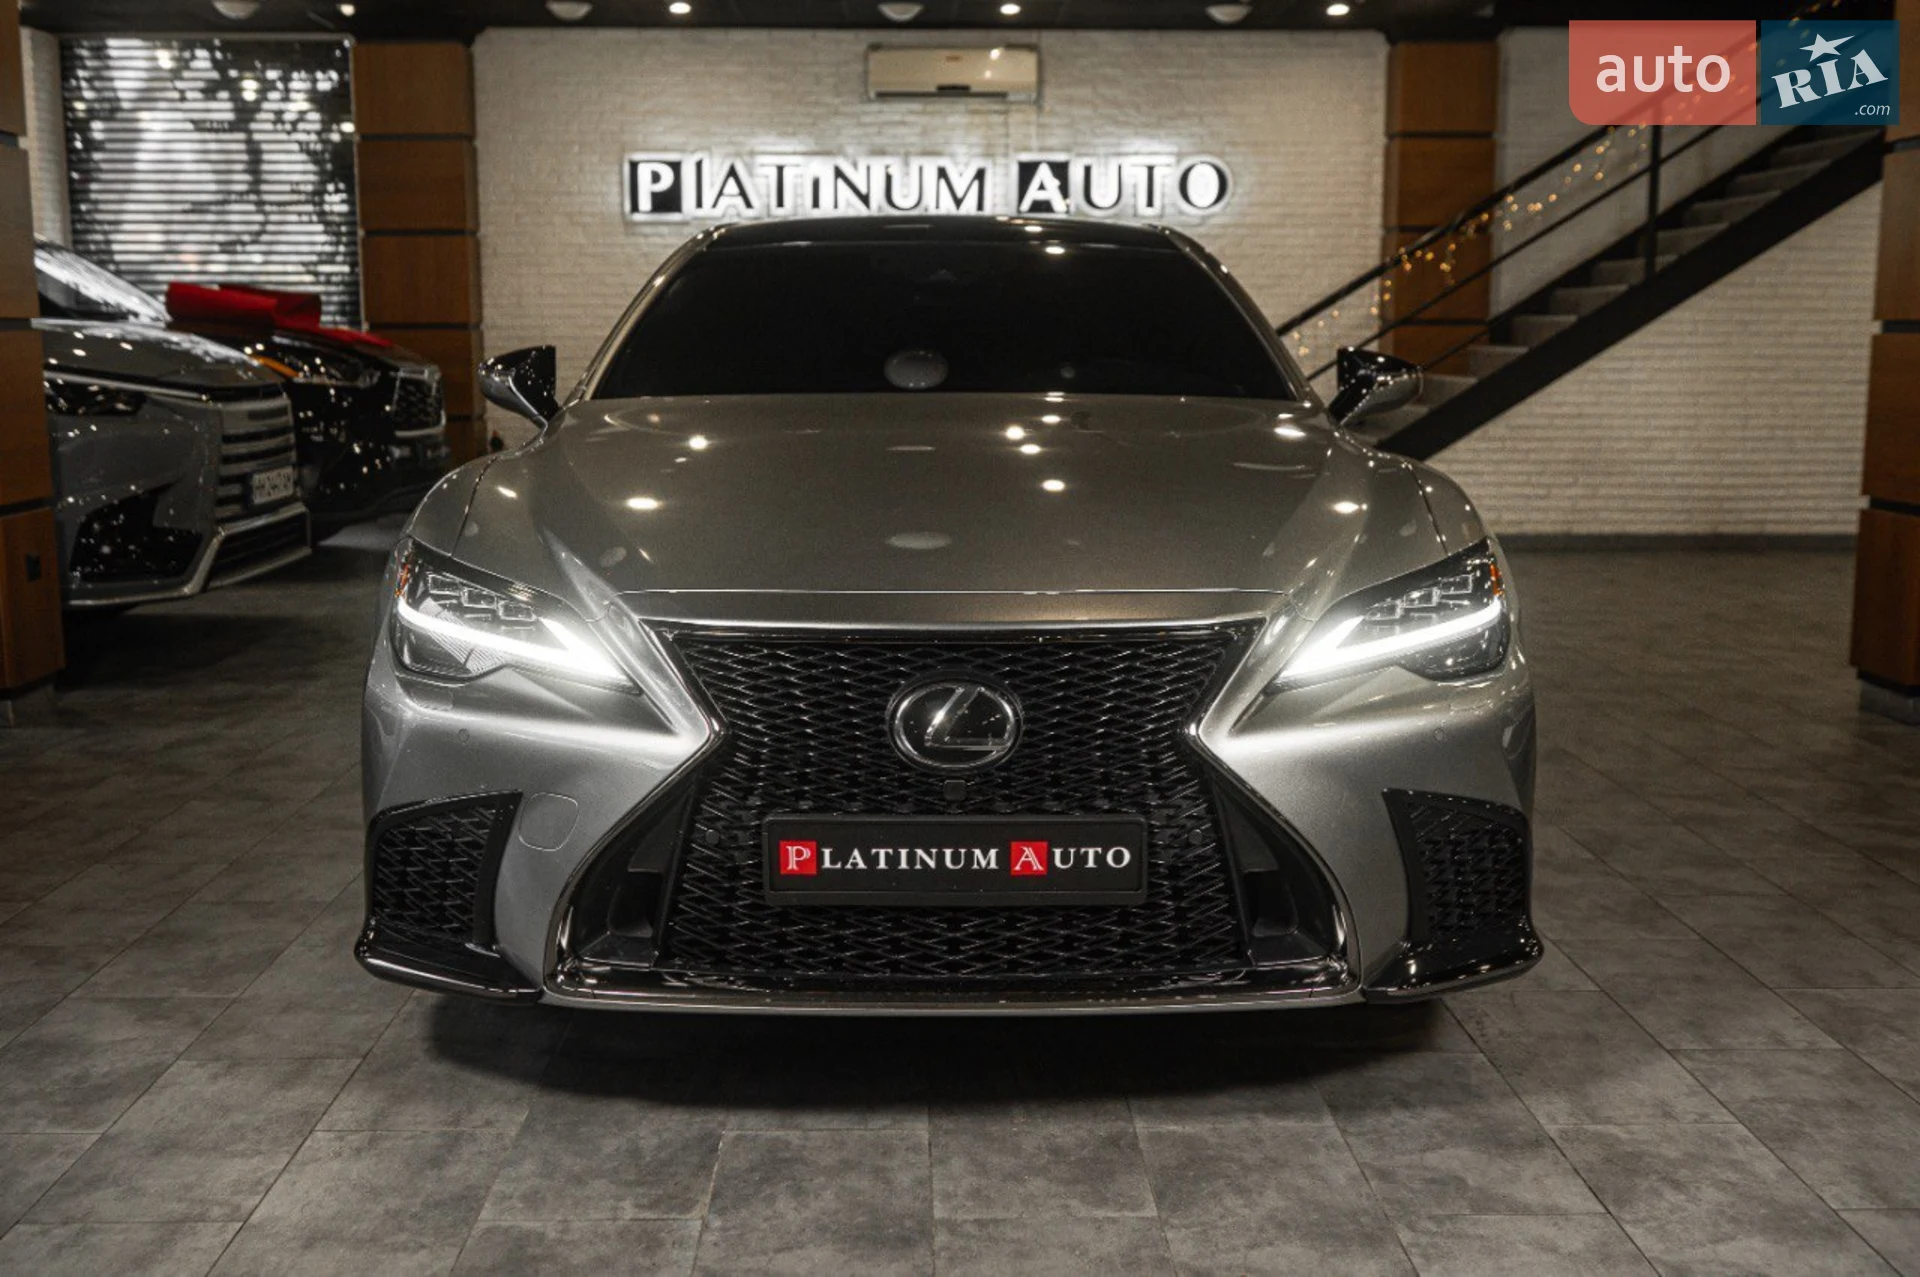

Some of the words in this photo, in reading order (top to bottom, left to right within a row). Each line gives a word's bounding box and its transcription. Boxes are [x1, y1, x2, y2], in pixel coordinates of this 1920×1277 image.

[630, 159, 987, 213] PLATINUM
[1018, 160, 1229, 213] AUTO
[783, 843, 999, 872] PLATINUM
[1012, 843, 1132, 872] AUTO
